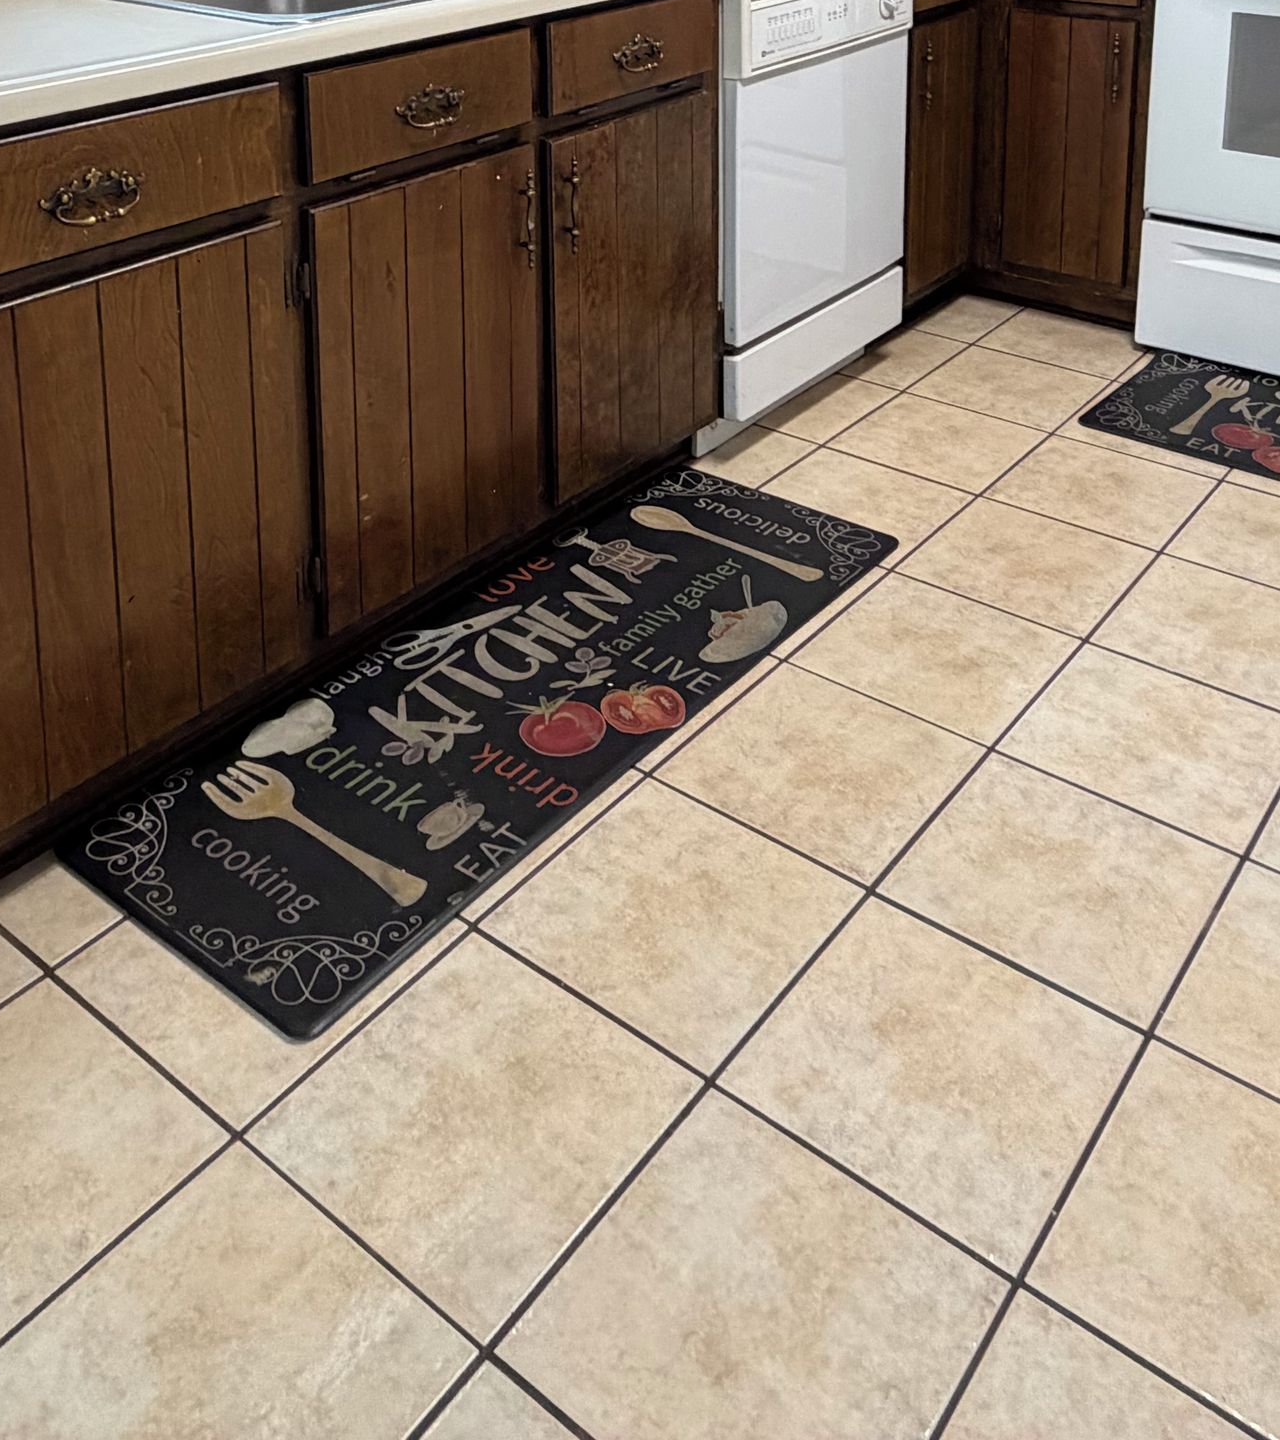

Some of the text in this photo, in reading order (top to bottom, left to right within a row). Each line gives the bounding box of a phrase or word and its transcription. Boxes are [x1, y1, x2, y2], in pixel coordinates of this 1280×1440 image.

[1145, 378, 1199, 415] cooking
[1186, 437, 1241, 458] EAT
[694, 497, 812, 545] delicious
[477, 556, 556, 603] love
[598, 558, 743, 656] family gather
[309, 650, 393, 700] laugh
[368, 563, 633, 745] KITCHEN
[631, 647, 722, 696] LIVE
[305, 745, 427, 822] drink
[470, 742, 579, 808] drink
[191, 828, 320, 924] cooking
[453, 821, 528, 883] EAT
